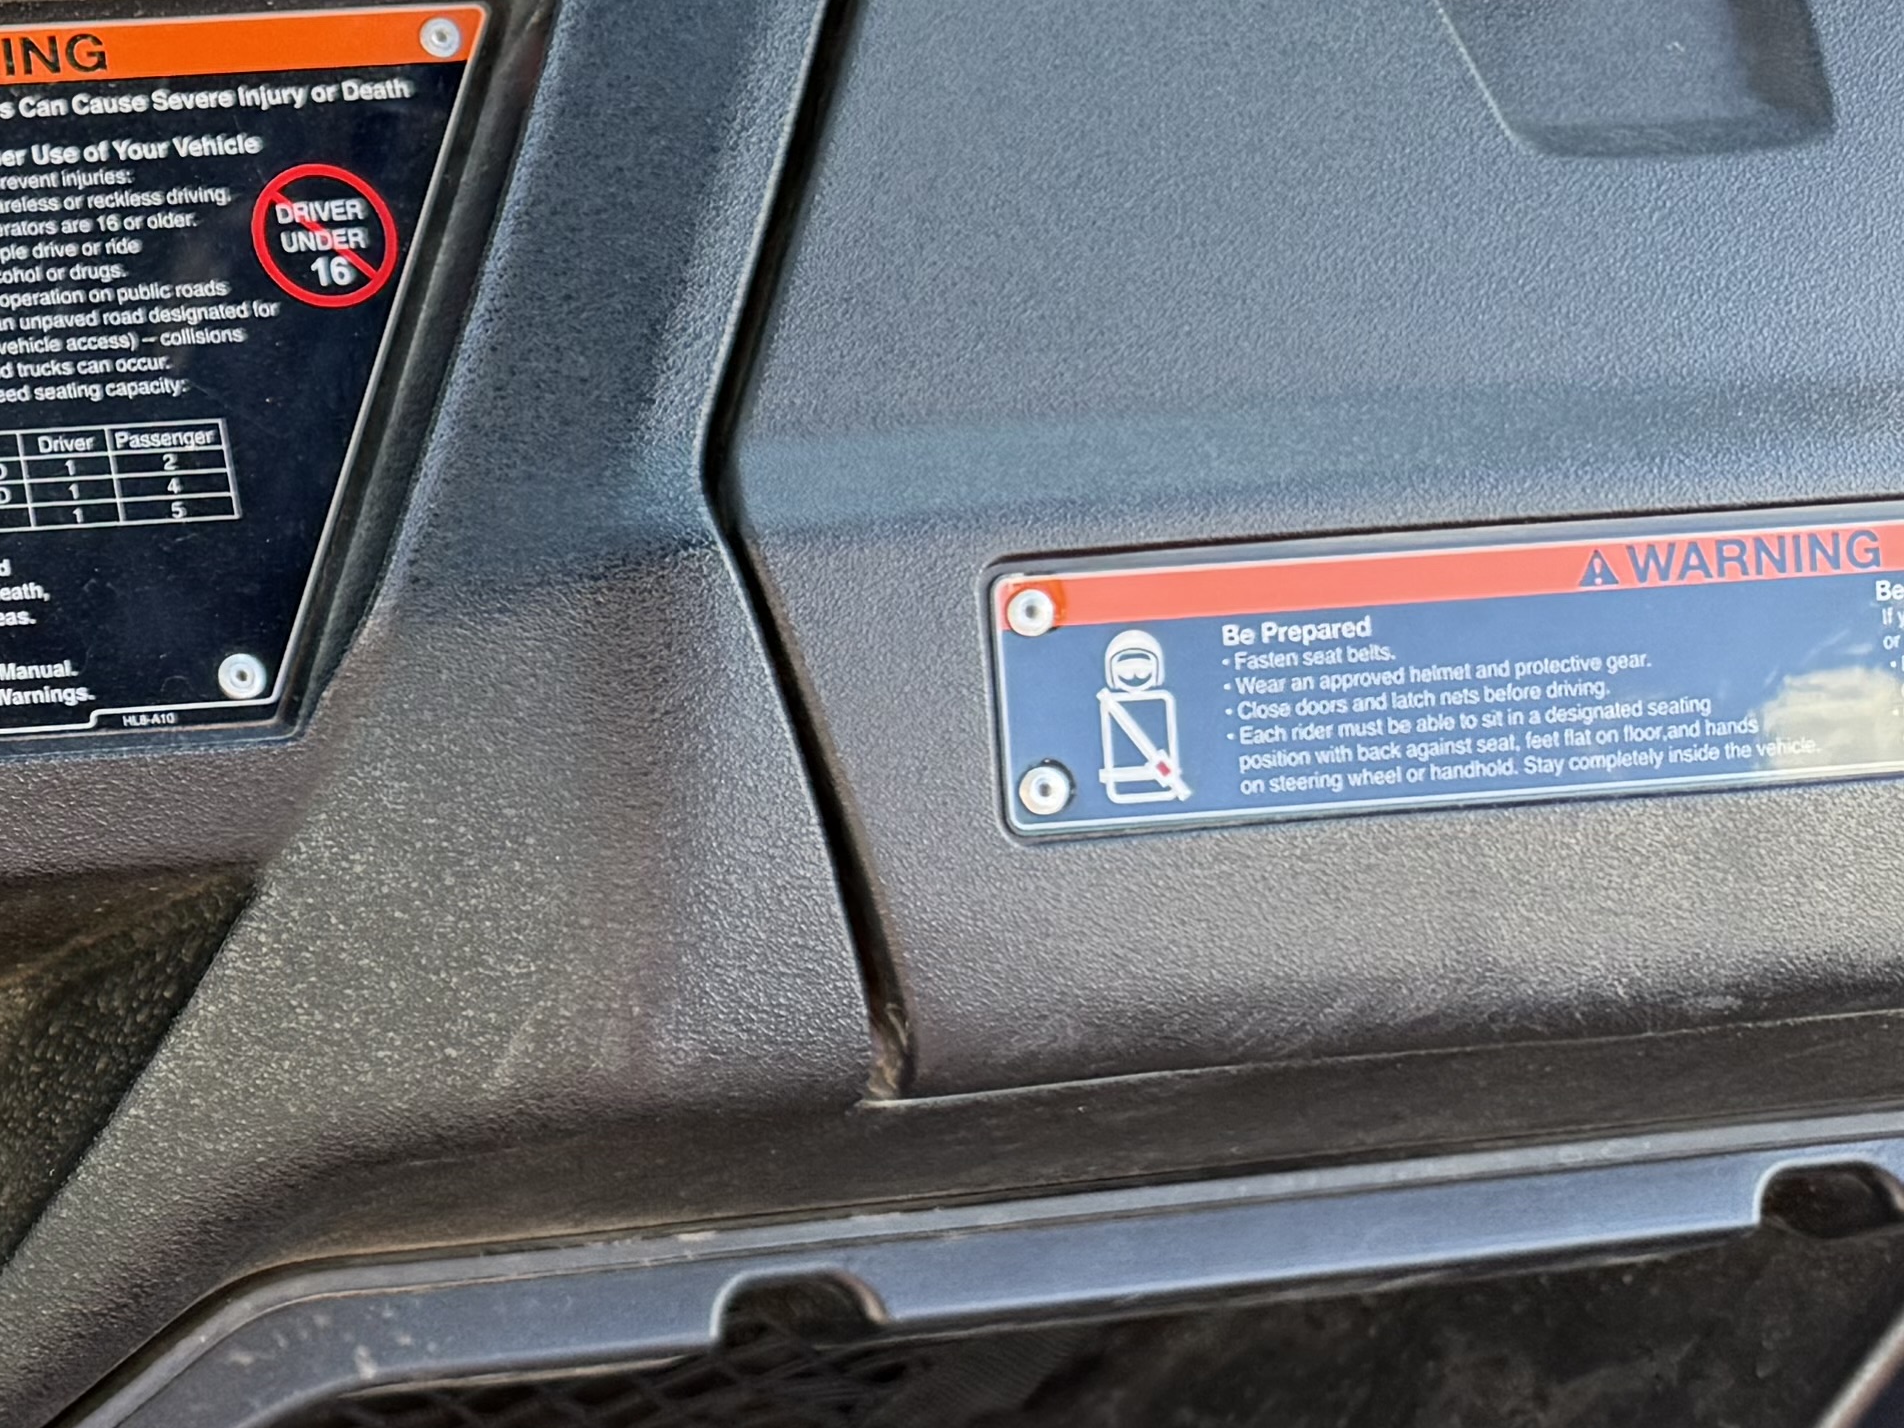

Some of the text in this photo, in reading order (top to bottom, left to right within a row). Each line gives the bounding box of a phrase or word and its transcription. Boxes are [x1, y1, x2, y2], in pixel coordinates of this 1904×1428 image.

[21, 96, 66, 116] Can
[71, 93, 147, 114] Cause
[152, 89, 234, 110] Severe
[239, 85, 306, 110] Injury
[313, 86, 339, 102] or
[344, 77, 411, 101] Death
[32, 144, 80, 164] Use
[84, 141, 108, 162] of
[112, 140, 169, 160] Your
[173, 134, 262, 157] Vehicle
[275, 198, 368, 224] DRIVER
[280, 226, 370, 253] UNDER
[311, 256, 356, 286] 16
[38, 434, 93, 453] Driver
[115, 430, 214, 449] Passenger
[65, 460, 76, 475] 1
[162, 453, 178, 471] 2
[68, 484, 81, 500] 1
[167, 477, 183, 494] 4
[72, 508, 84, 523] 1
[171, 501, 187, 519] 5
[1627, 529, 1881, 584] WARNING
[1222, 615, 1372, 647] Be Prepared
[1234, 643, 1396, 670] Fasten seat belts.
[0, 660, 78, 681] Manual.
[1235, 654, 1651, 695] Wear an approved helmet and protective gear.
[1237, 679, 1610, 720] Close doors and latch nets before driving.
